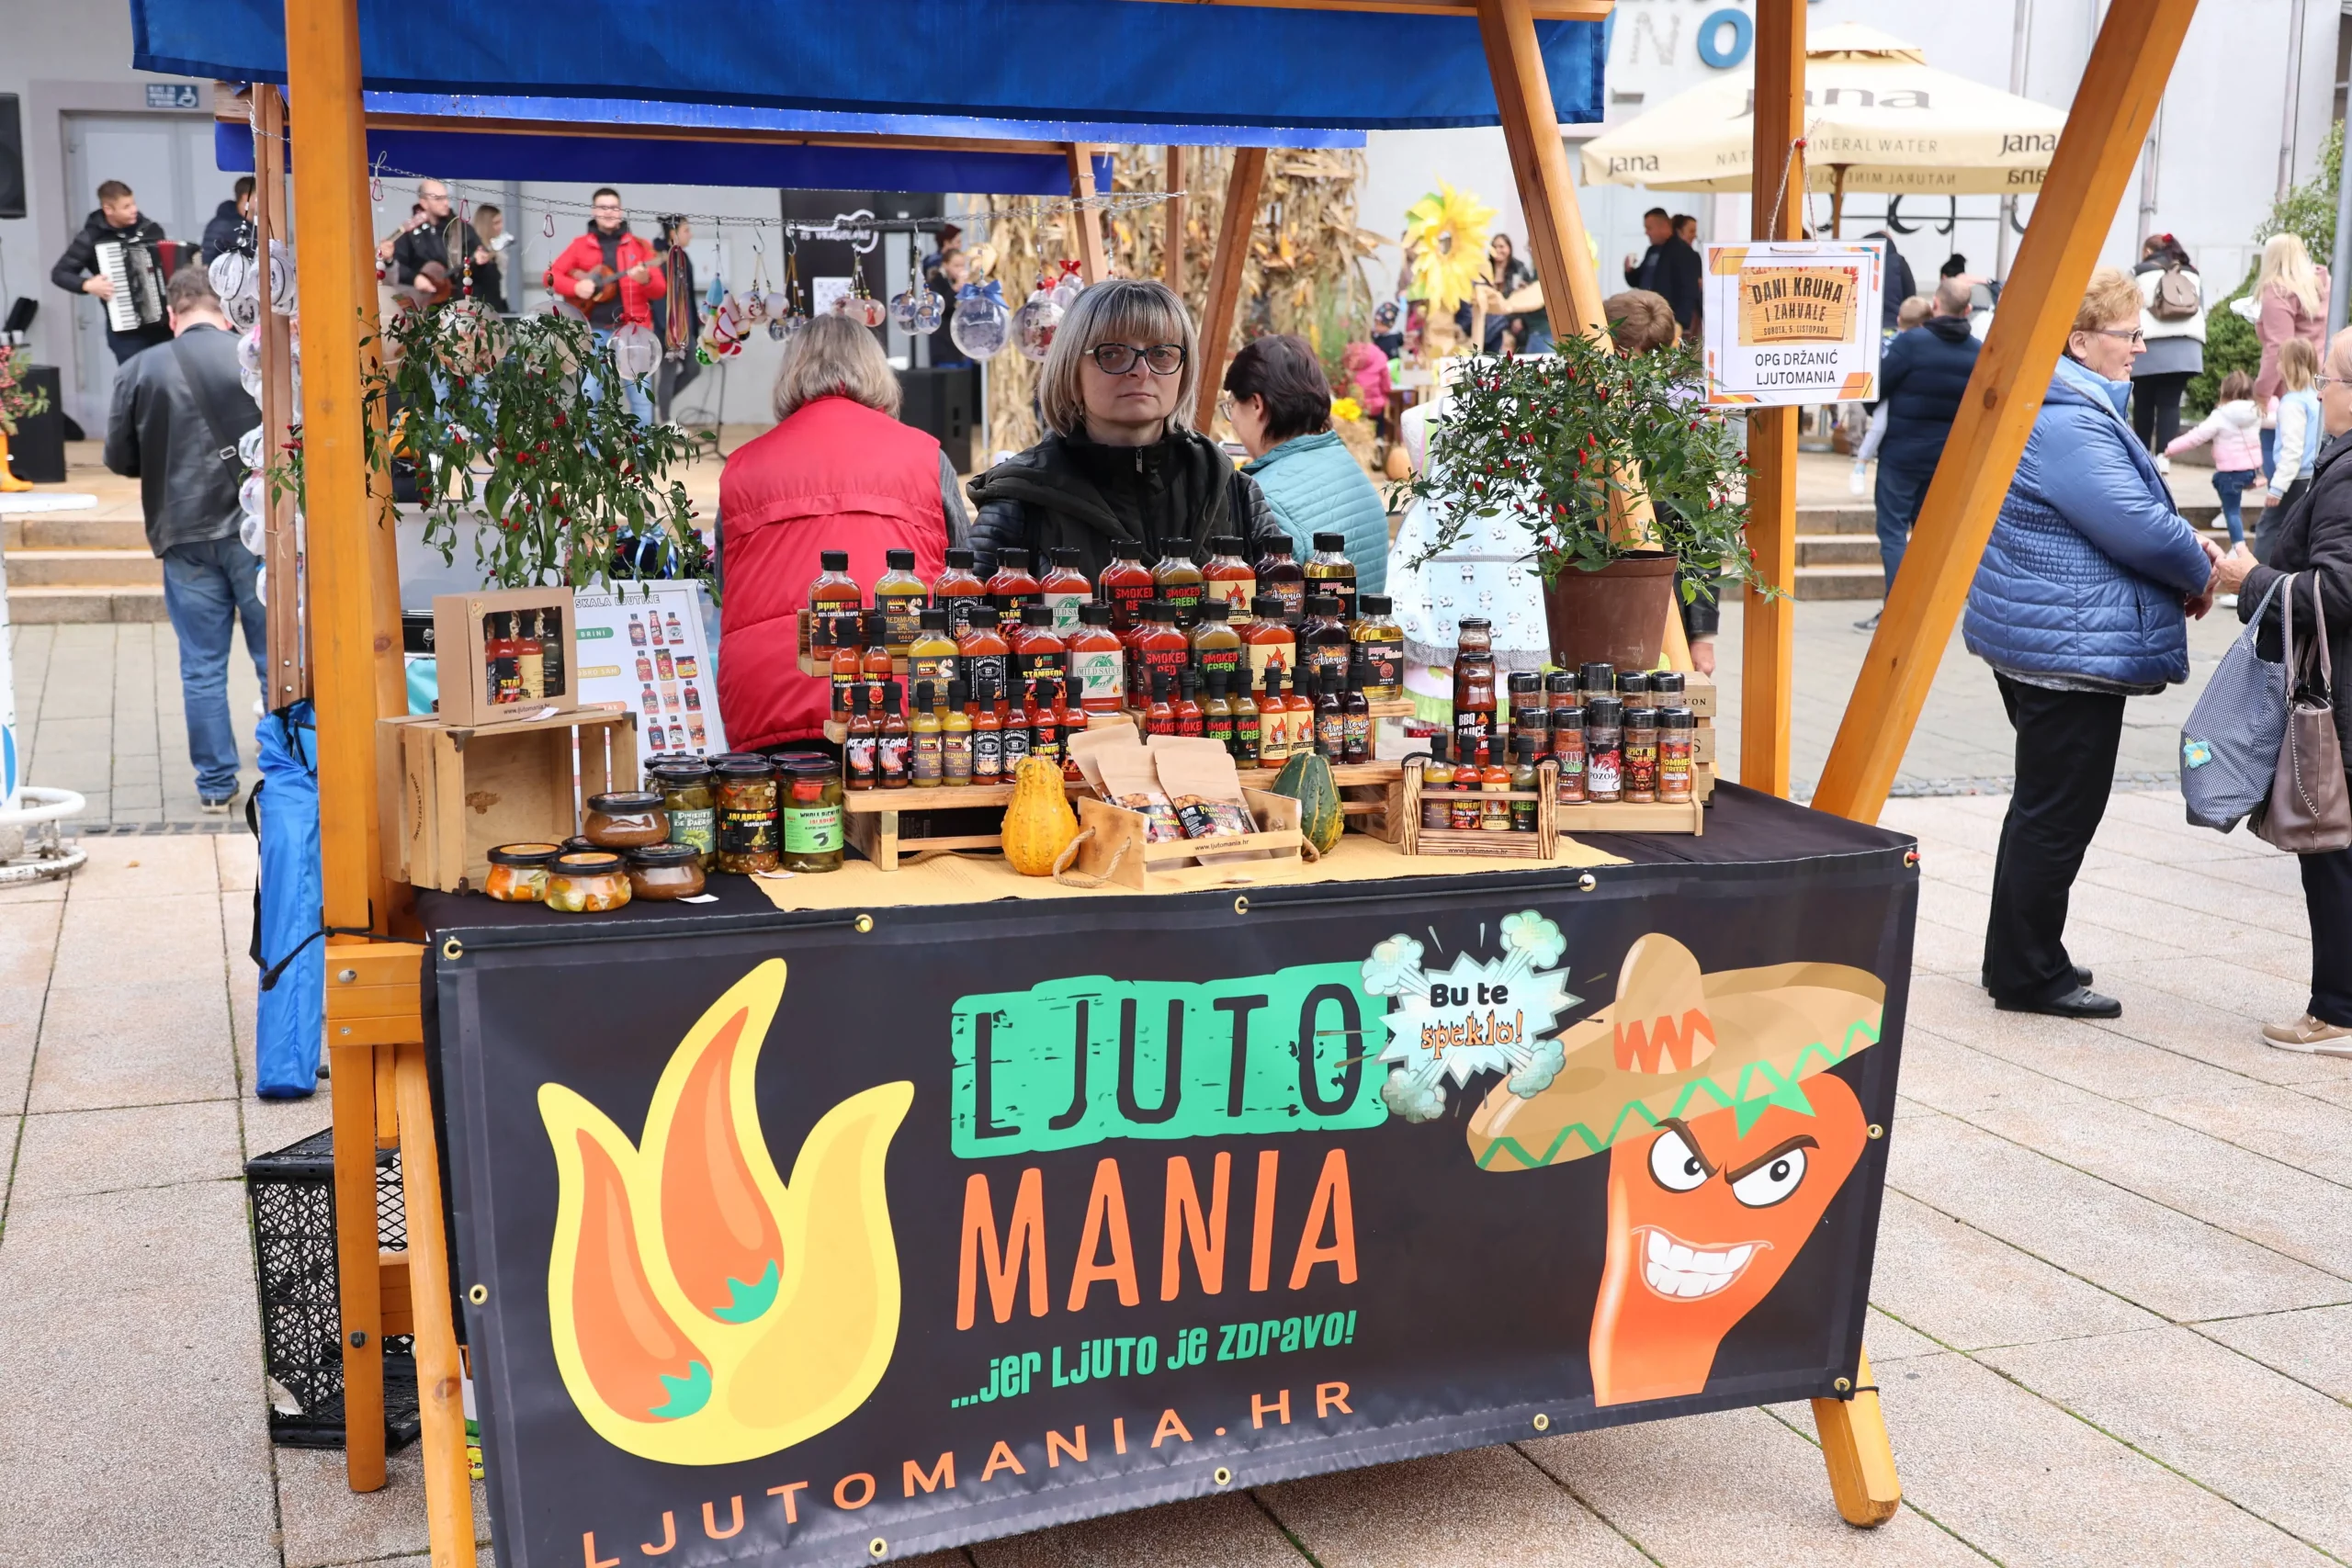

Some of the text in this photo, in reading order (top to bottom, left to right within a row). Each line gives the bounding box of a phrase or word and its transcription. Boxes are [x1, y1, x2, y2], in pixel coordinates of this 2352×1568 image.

[1878, 141, 1938, 153] WATER
[1752, 276, 1844, 305] DANI KRUHA
[1765, 302, 1826, 322] I ZAHVALE
[1796, 324, 1828, 334] LISTOPADA
[1755, 349, 1838, 367] OPG DRŽANIĆ
[1757, 370, 1836, 386] LJUTOMANIA
[1115, 588, 1154, 599] SMOKED
[1166, 587, 1200, 598] SMOKED
[575, 598, 612, 608] SKALA
[1125, 600, 1139, 611] RE
[1052, 608, 1067, 616] ILD
[1146, 652, 1186, 664] SMOKED
[1202, 652, 1238, 664] SMOKED
[1313, 653, 1349, 665] Aronia
[1079, 667, 1121, 676] MILD SAUCE
[1459, 713, 1476, 726] BBQ
[1458, 724, 1487, 737] SAUCE
[1660, 758, 1691, 766] POMMES
[1194, 840, 1250, 852] www.ljutomania.hr
[1448, 847, 1509, 855] www.ljutomania.hr
[1430, 982, 1509, 1008] Bu te
[1420, 1009, 1523, 1060] speklo!
[974, 983, 1363, 1139] LJUTO
[956, 1148, 1358, 1331] MANIA
[1167, 1326, 1208, 1371] je
[582, 1381, 1354, 1568] LJUTOMANIA.HR
